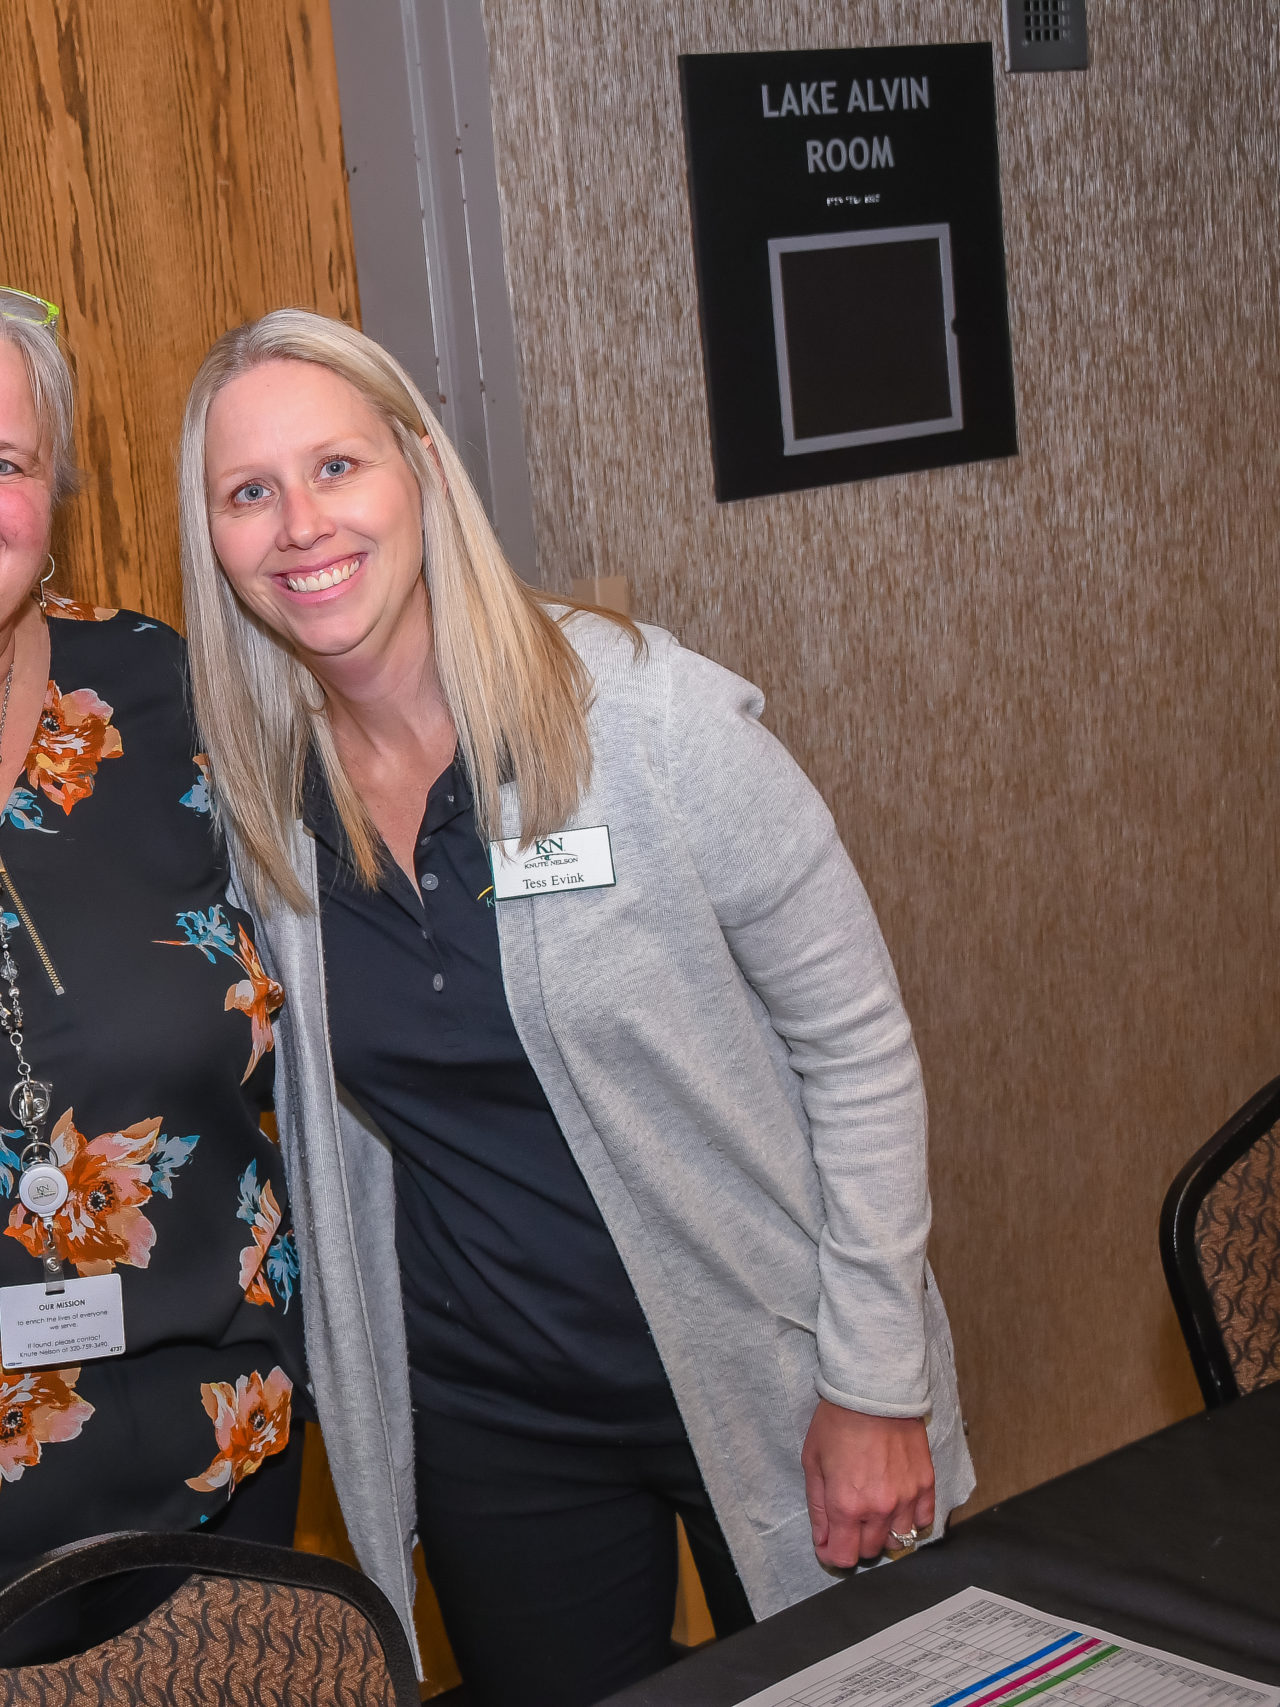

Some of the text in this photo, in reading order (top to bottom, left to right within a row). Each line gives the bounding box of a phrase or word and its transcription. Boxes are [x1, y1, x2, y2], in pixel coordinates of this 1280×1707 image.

[761, 76, 931, 119] LAKE ALVIN
[806, 135, 895, 174] ROOM
[536, 837, 563, 855] KN
[524, 857, 579, 870] KNUTE NELSON
[522, 872, 585, 890] Tess Evink
[38, 1299, 86, 1311] OUR MISSION
[17, 1319, 24, 1327] to
[25, 1317, 45, 1326] enrich
[46, 1316, 57, 1324] the
[57, 1314, 71, 1322] lives
[79, 1309, 108, 1320] everyone
[54, 1338, 76, 1347] please
[76, 1334, 101, 1343] contact
